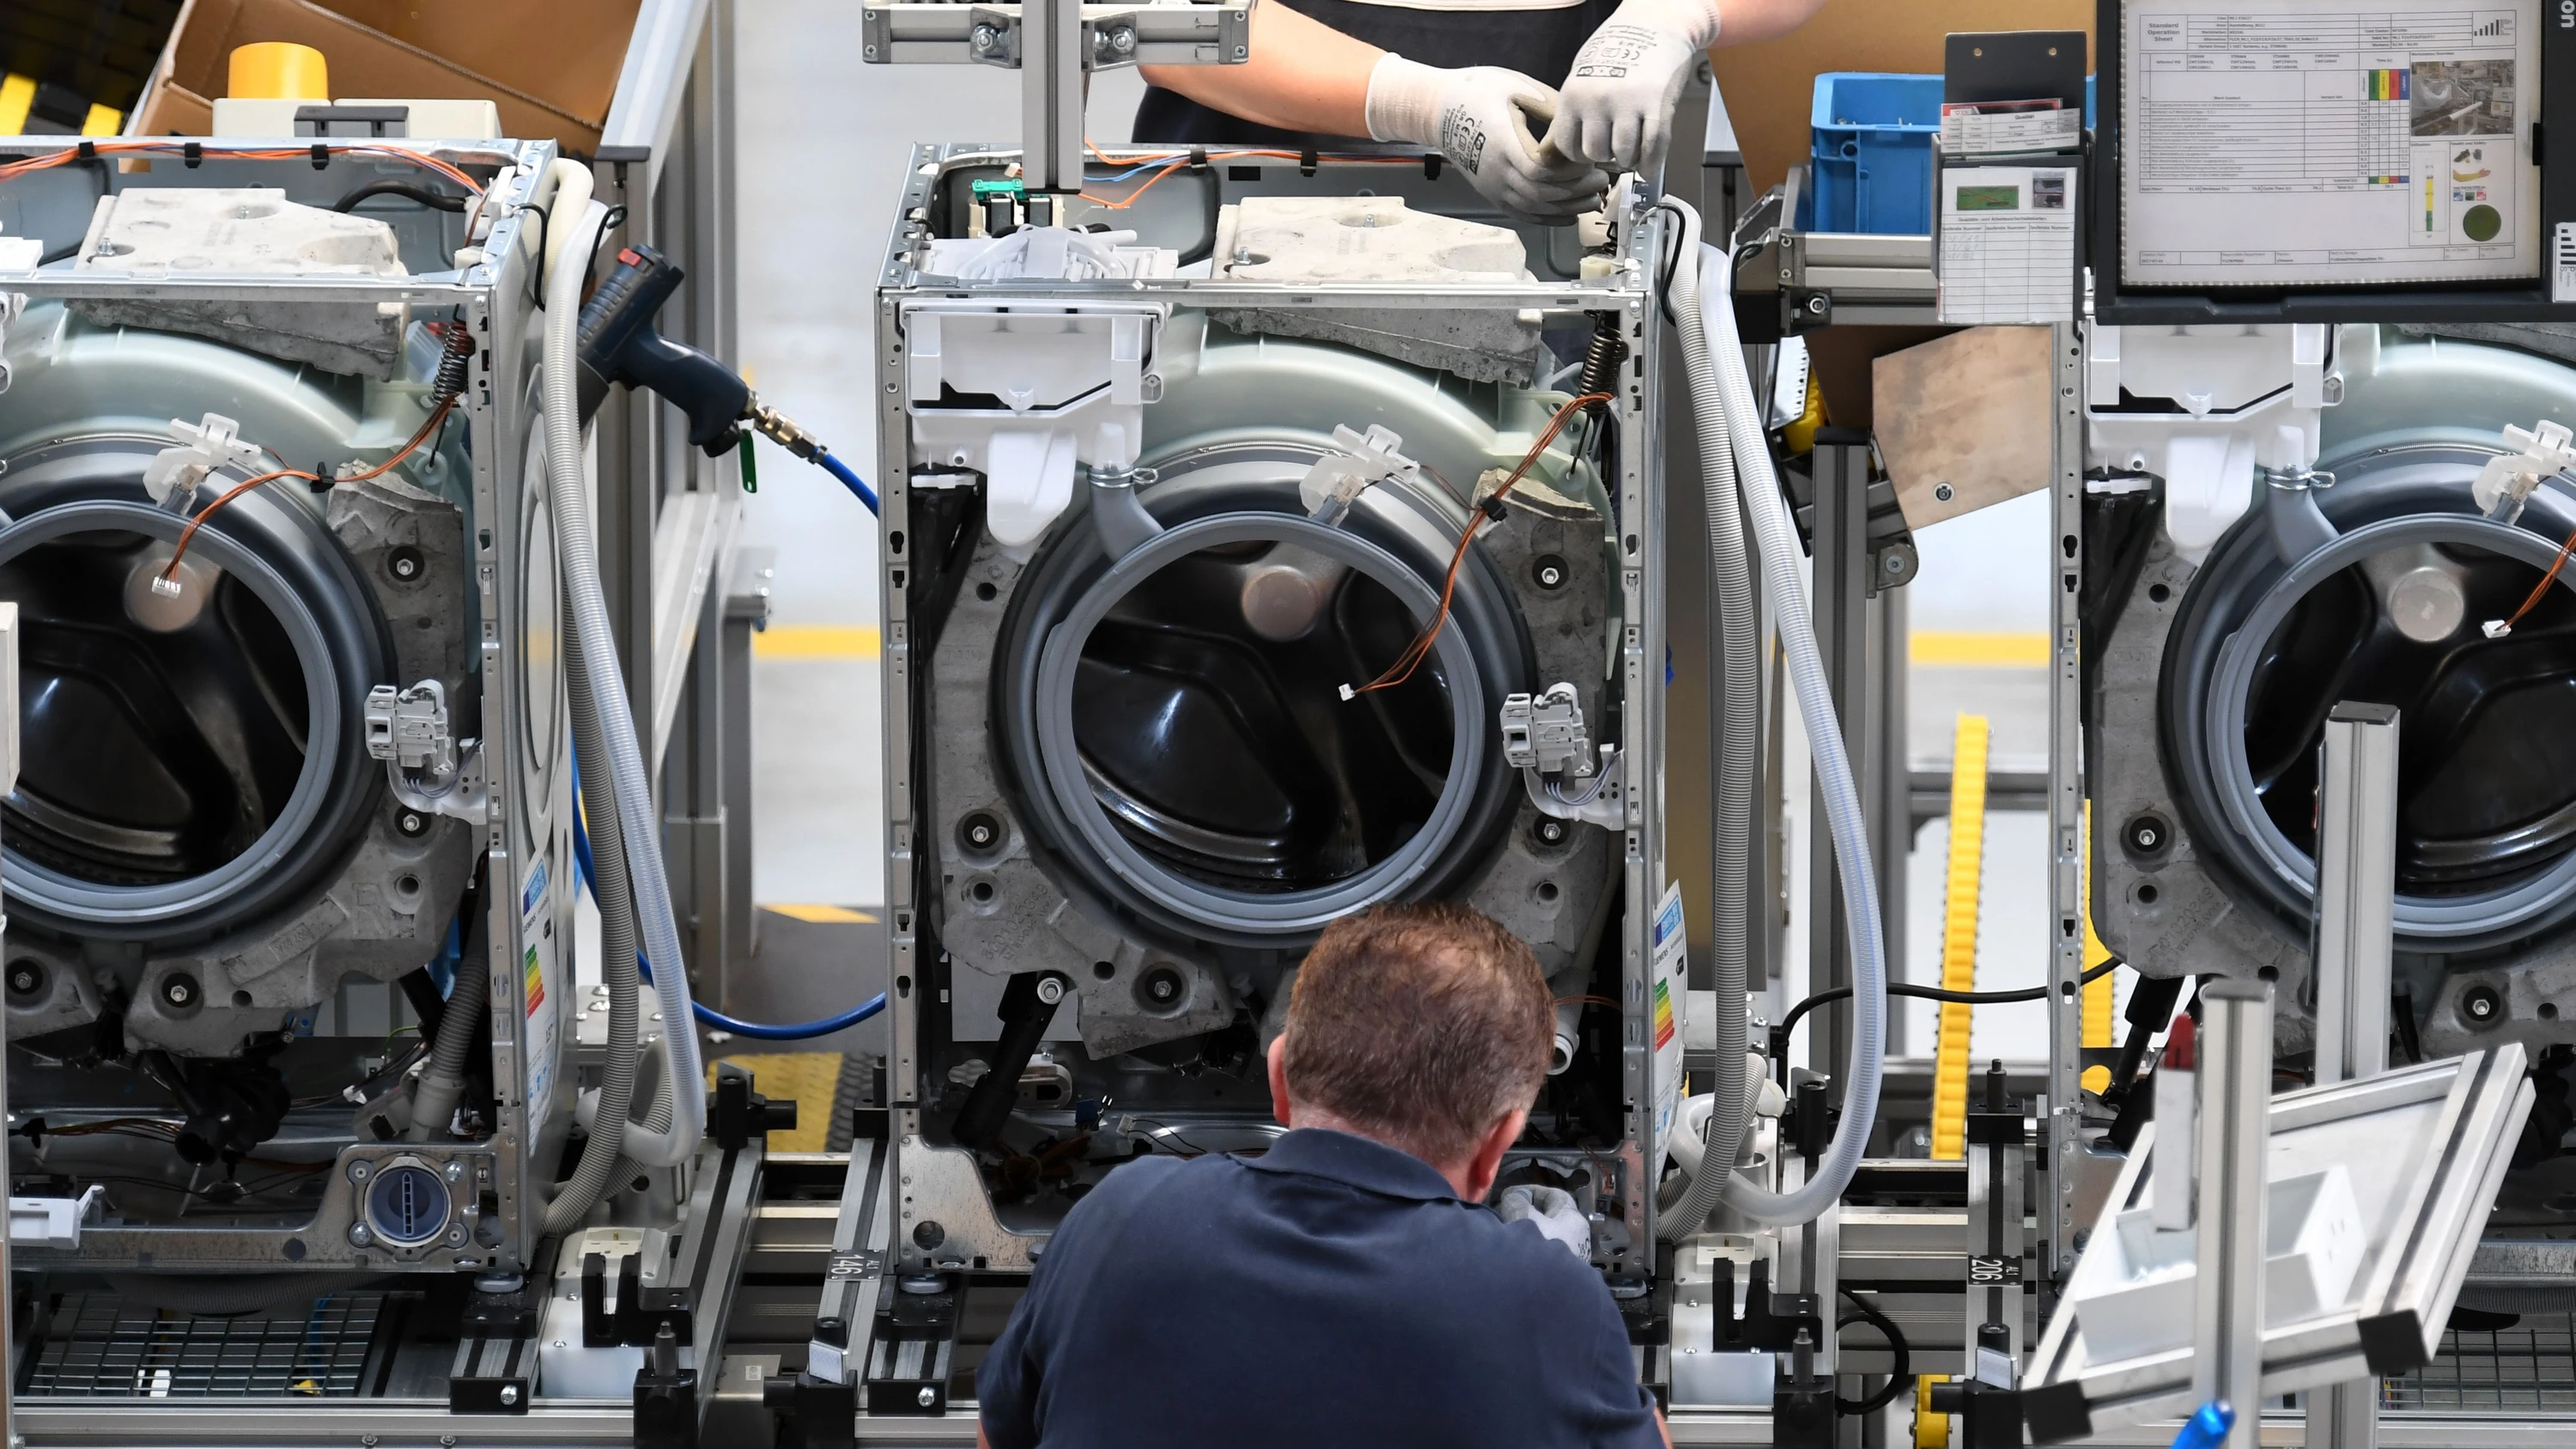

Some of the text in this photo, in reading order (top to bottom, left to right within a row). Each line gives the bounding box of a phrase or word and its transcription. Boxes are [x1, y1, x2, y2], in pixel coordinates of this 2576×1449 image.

[830, 1254, 865, 1275] 146
[866, 1260, 880, 1269] AL1
[1971, 1259, 2004, 1281] 206
[2006, 1265, 2020, 1276] AL1
